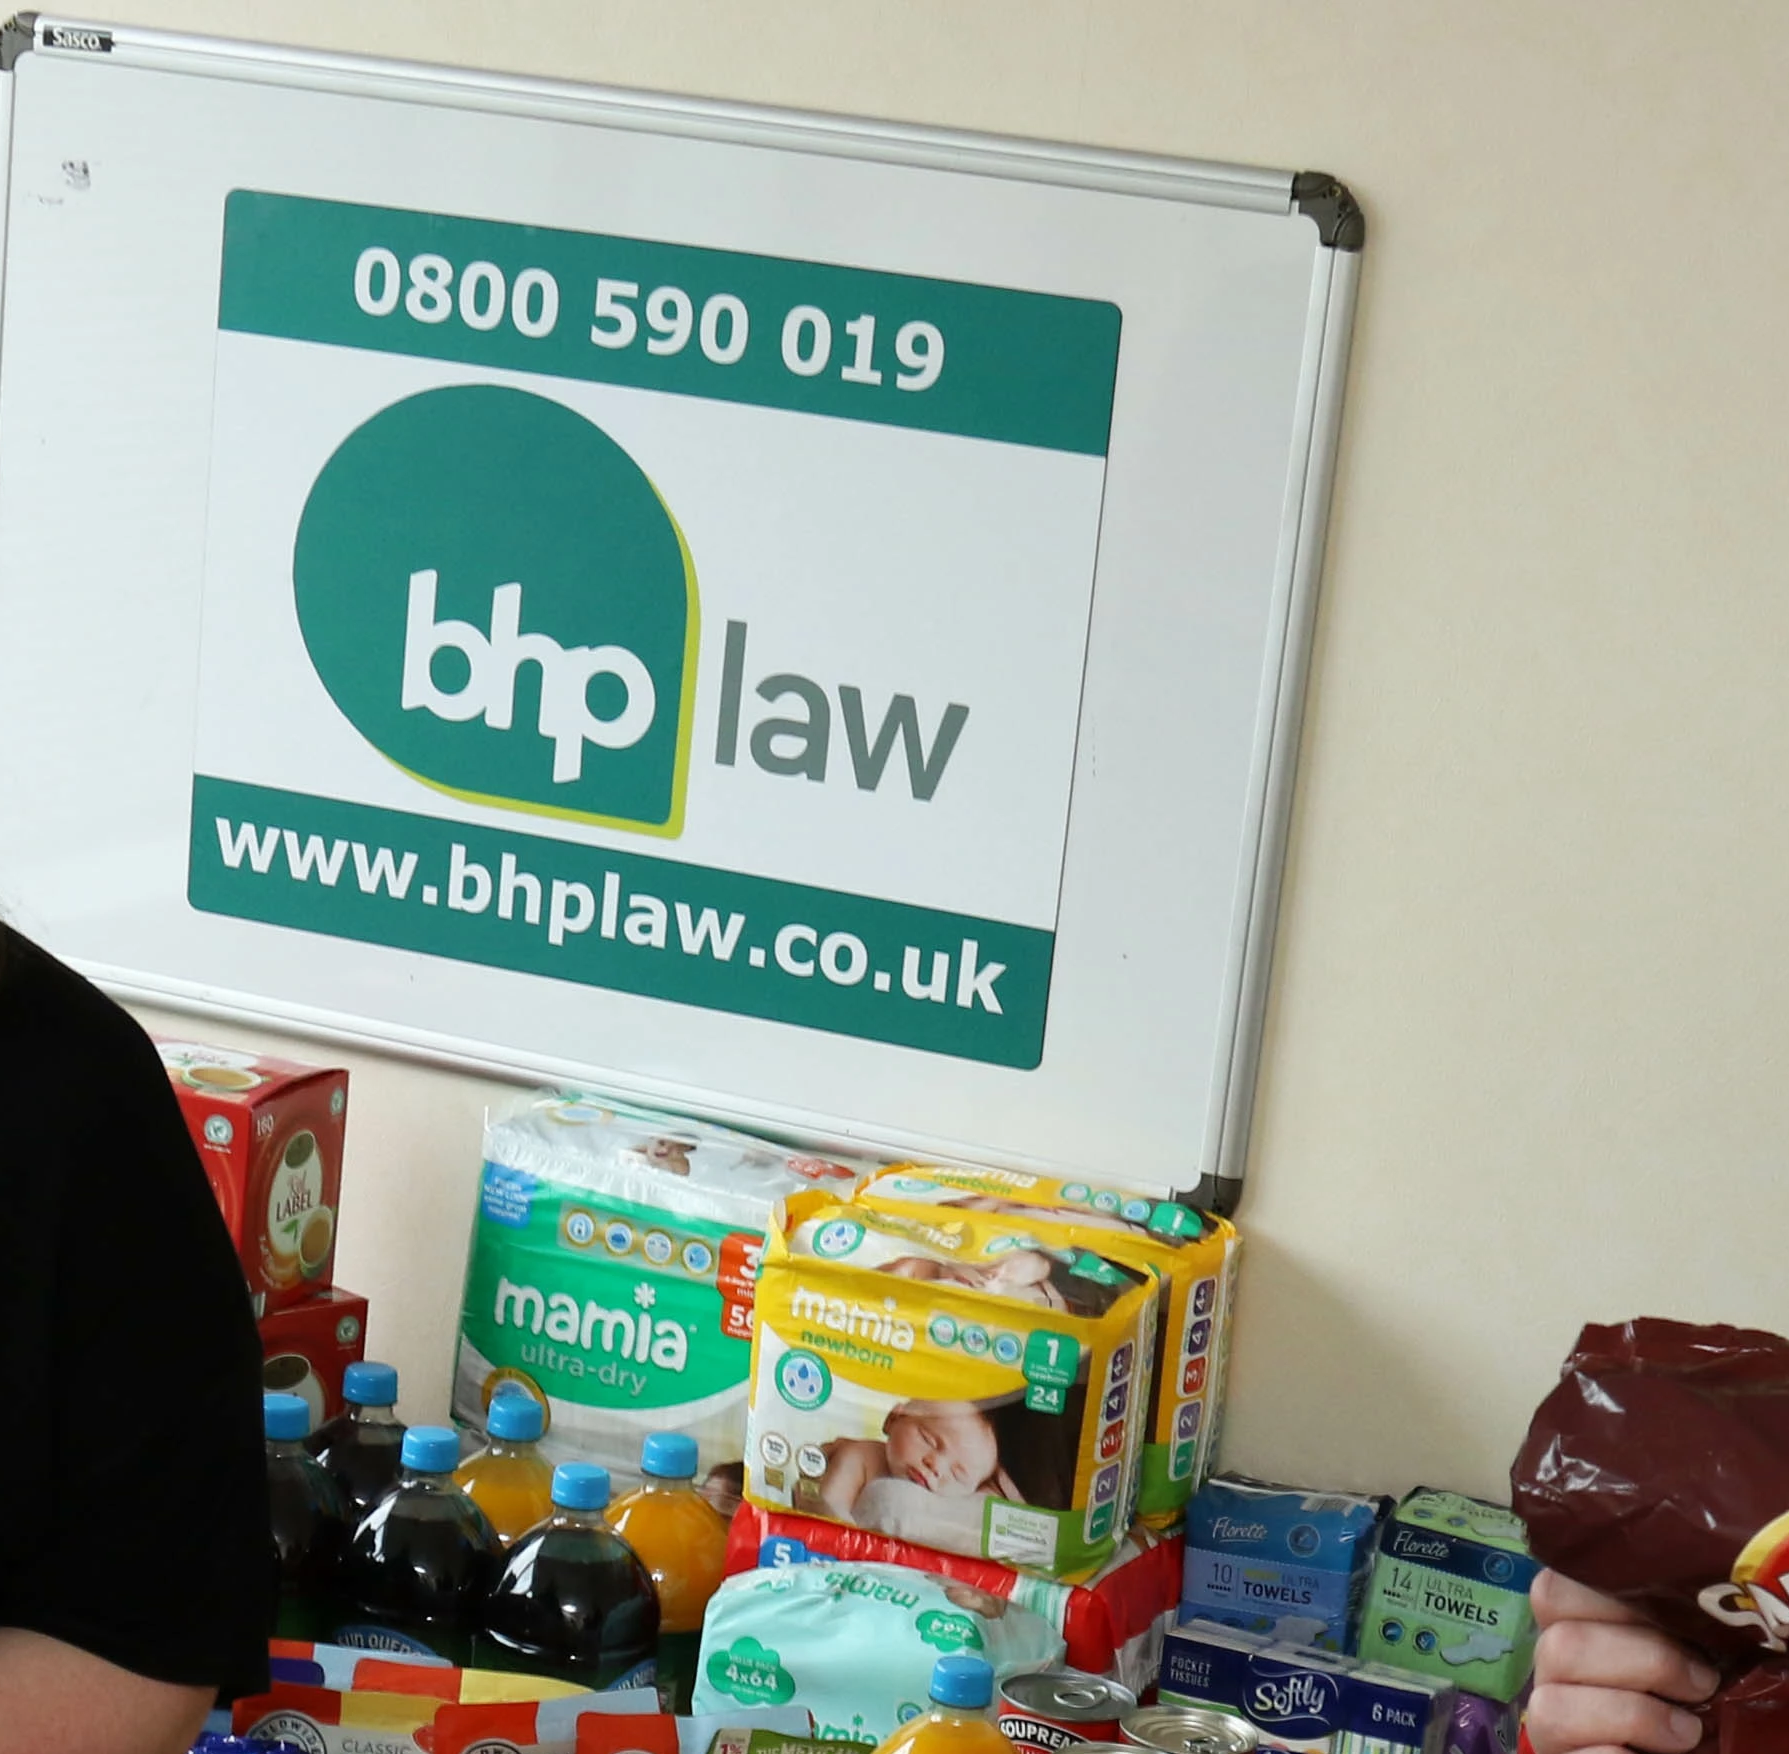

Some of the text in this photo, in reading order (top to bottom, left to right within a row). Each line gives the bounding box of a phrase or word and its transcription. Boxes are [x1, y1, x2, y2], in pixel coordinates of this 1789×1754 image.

[52, 27, 101, 49] Sasco
[351, 246, 947, 393] 0800 590 019
[401, 567, 970, 802] bhp law
[213, 814, 1007, 1017] www.bhplaw.co.uk
[493, 1275, 689, 1373] mamia
[789, 1285, 915, 1352] mamia
[801, 1327, 894, 1370] newborn
[520, 1341, 647, 1398] ultra-dry
[1031, 1385, 1060, 1407] 24
[1212, 1516, 1268, 1539] Florette
[1392, 1530, 1450, 1559] Florette
[1213, 1562, 1232, 1584] 10
[1391, 1566, 1413, 1592] 14
[1243, 1581, 1312, 1604] TOWELS
[1426, 1575, 1474, 1600] ULTRA
[1424, 1591, 1500, 1626] TOWELS
[724, 1665, 779, 1692] 4x64
[1169, 1668, 1211, 1688] TISSUES
[1170, 1655, 1212, 1676] POCKET
[1254, 1673, 1325, 1716] Softly
[1372, 1703, 1416, 1728] 6 PACK
